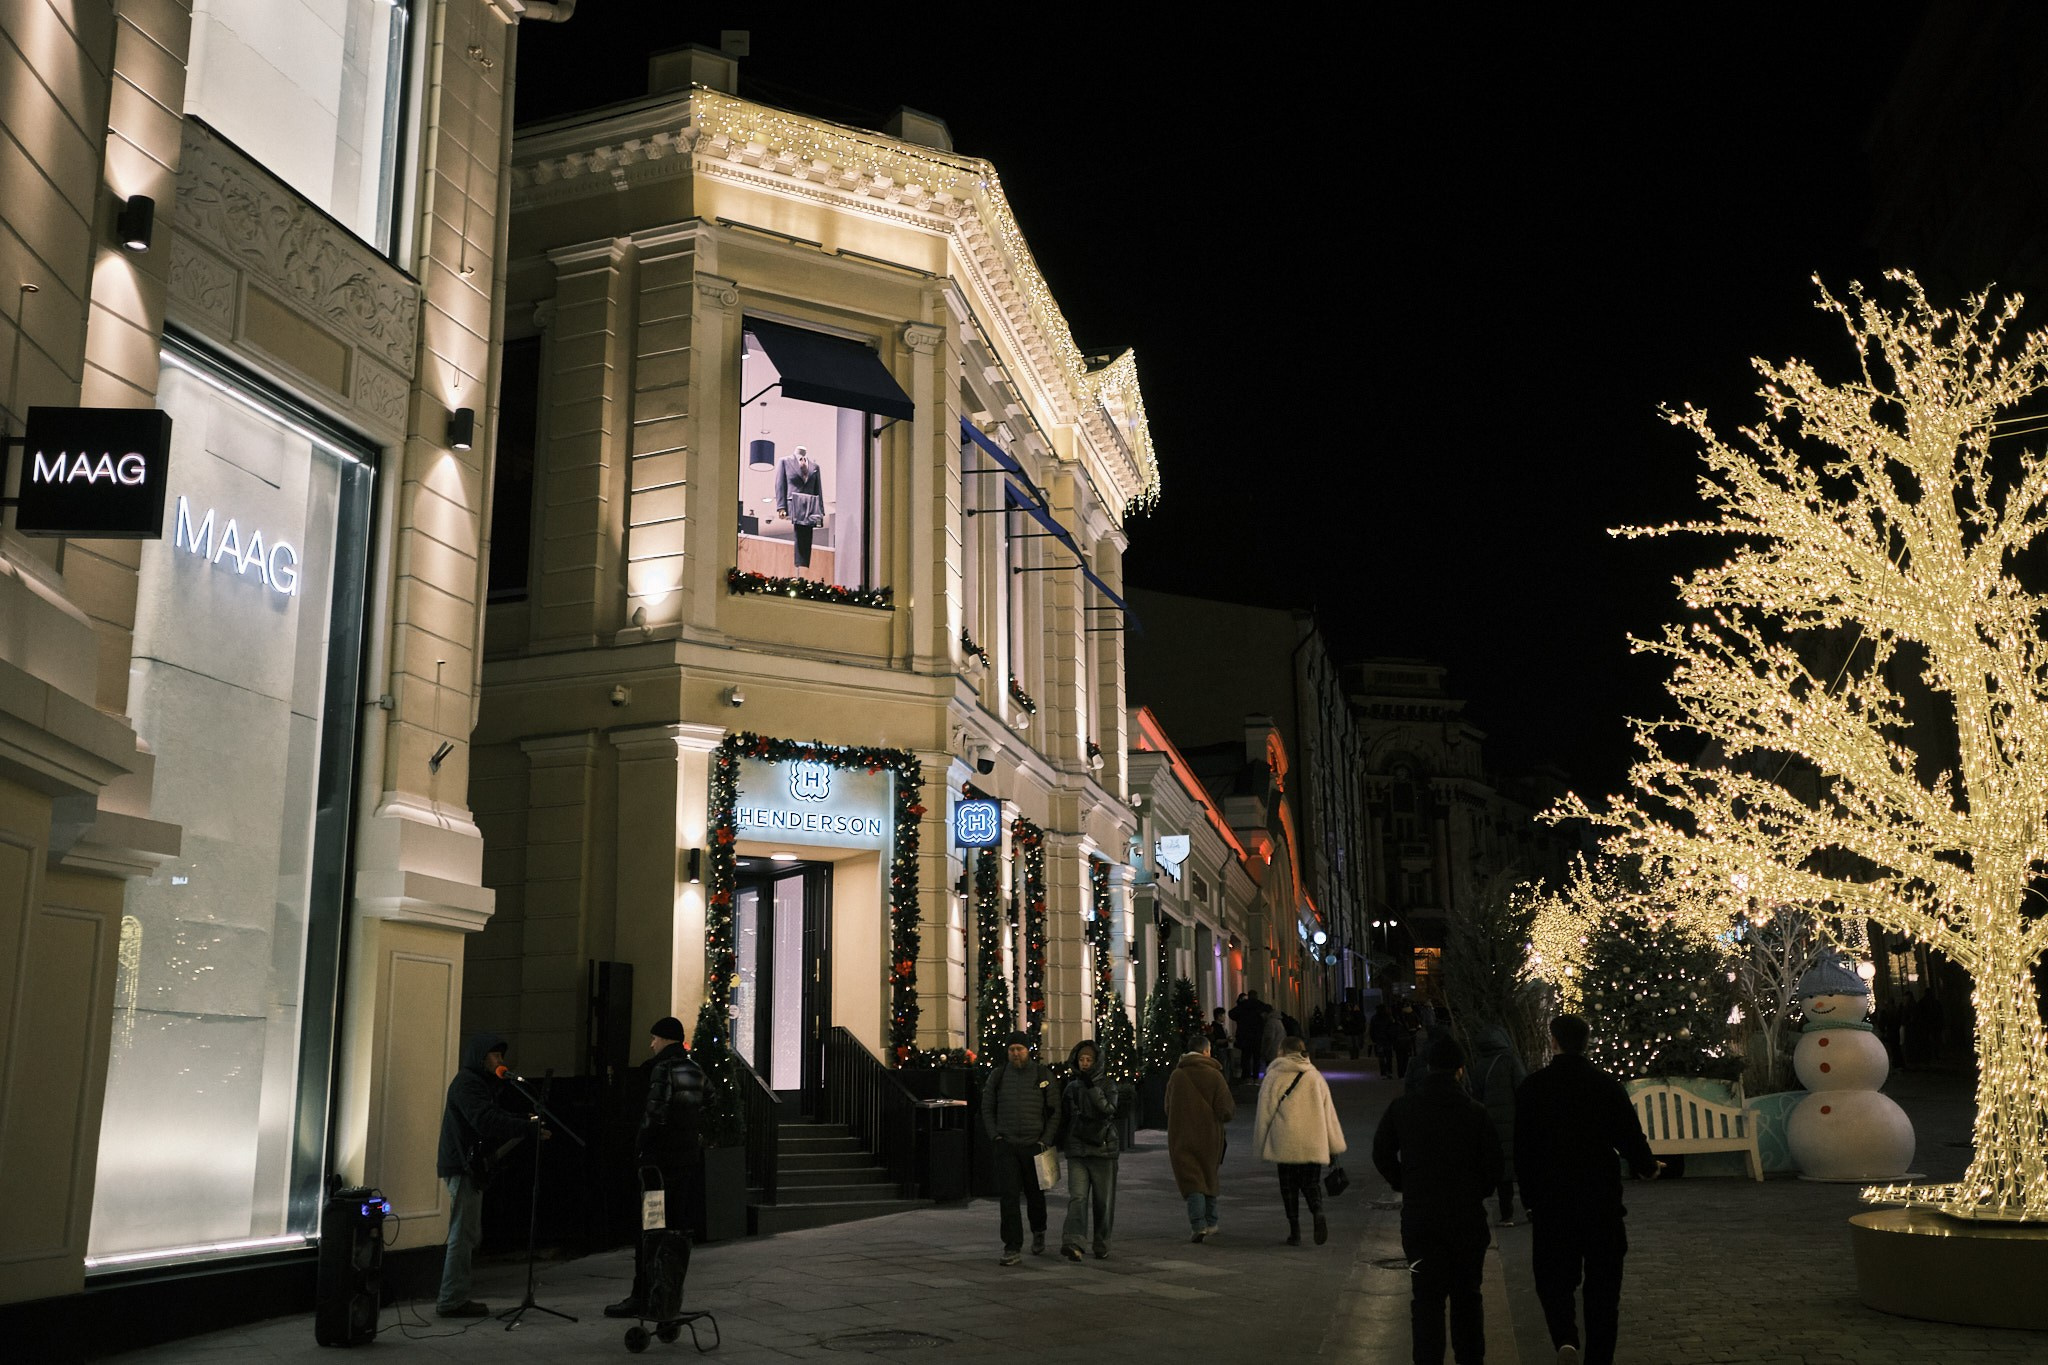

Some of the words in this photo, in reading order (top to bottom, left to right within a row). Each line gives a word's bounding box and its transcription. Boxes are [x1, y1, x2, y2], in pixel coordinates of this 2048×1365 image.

[33, 451, 146, 484] MAAG
[175, 495, 298, 597] MAAG
[803, 770, 820, 789] H
[736, 806, 882, 837] HENDERSON
[968, 814, 986, 832] H
